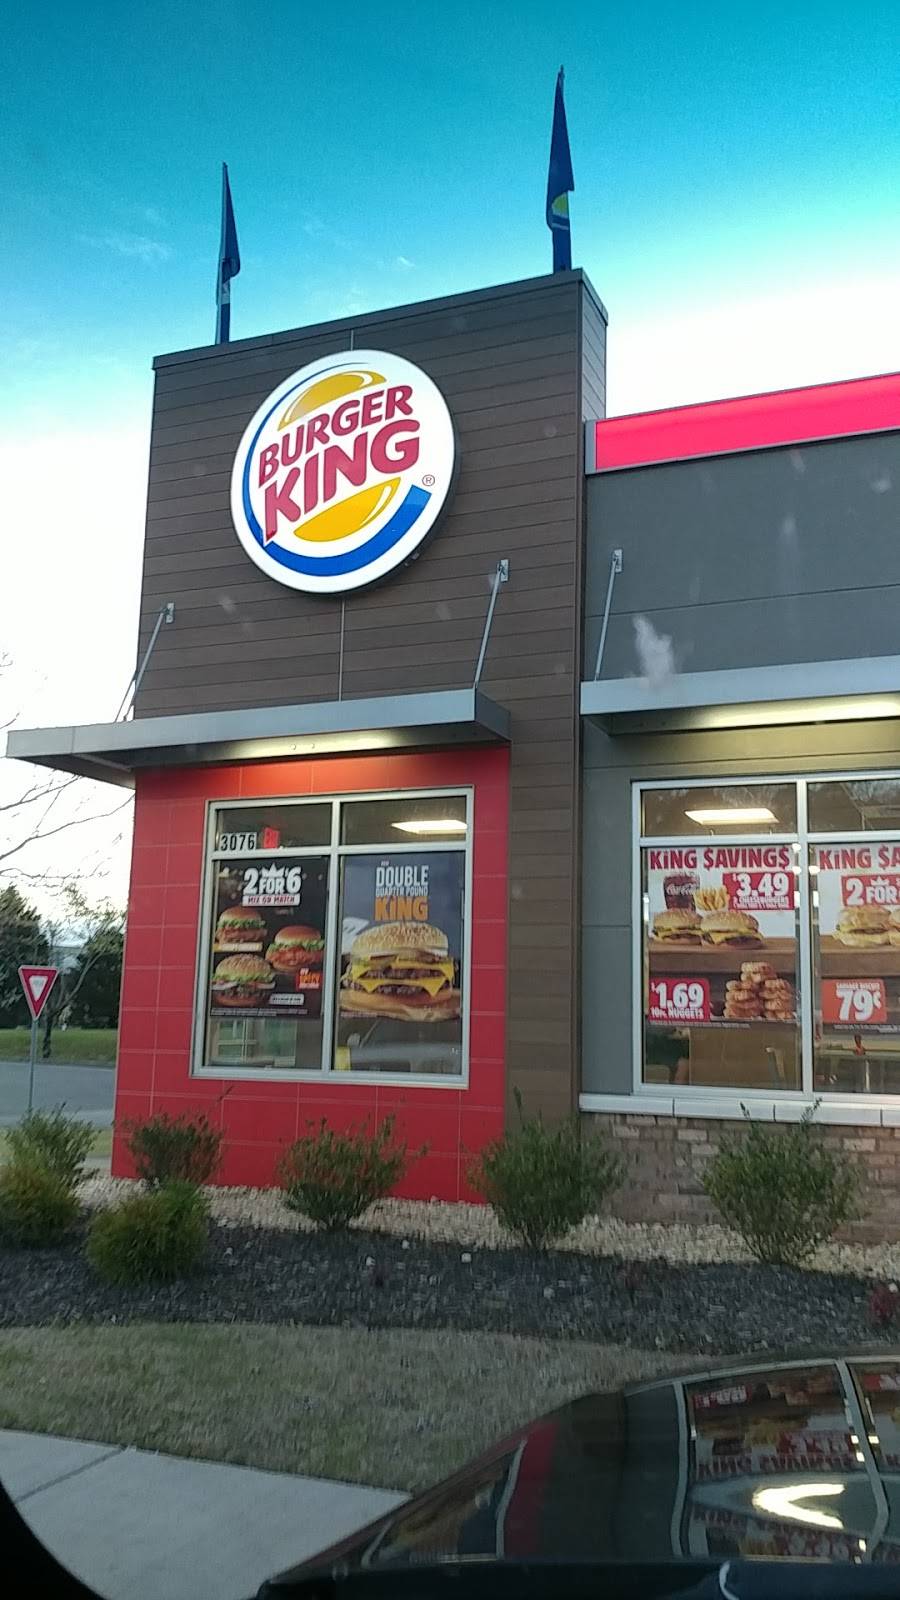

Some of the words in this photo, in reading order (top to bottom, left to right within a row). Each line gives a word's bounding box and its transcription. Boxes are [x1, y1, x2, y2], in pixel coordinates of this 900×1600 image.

[259, 385, 413, 488] BURGER
[264, 419, 420, 541] KING
[221, 833, 256, 852] 3076
[243, 867, 259, 896] 2
[259, 877, 285, 895] FOR
[376, 865, 429, 888] DOUBLE
[846, 878, 865, 906] 2
[866, 885, 897, 904] FOR
